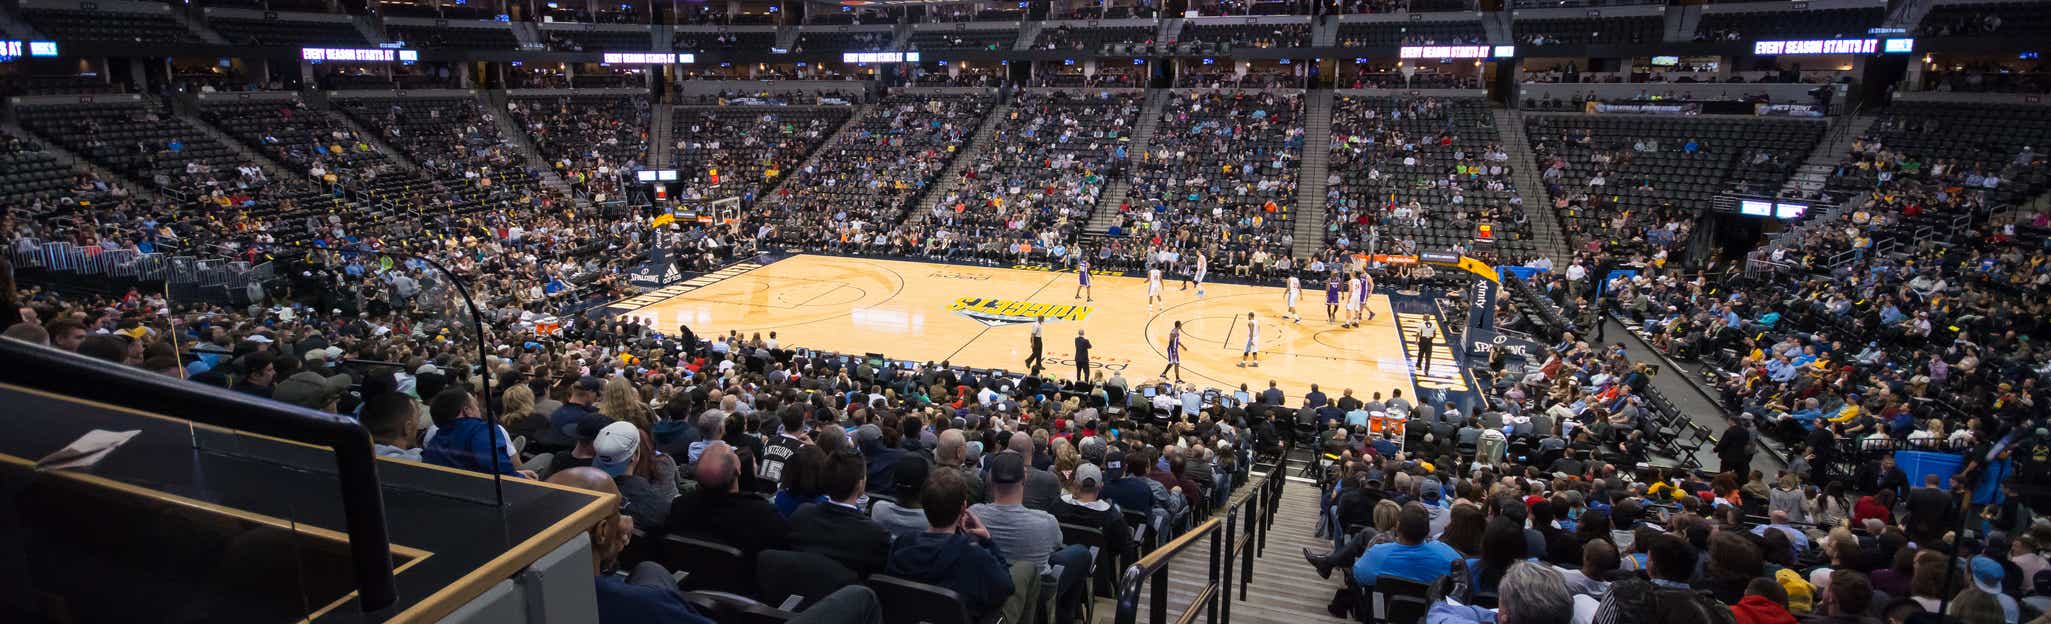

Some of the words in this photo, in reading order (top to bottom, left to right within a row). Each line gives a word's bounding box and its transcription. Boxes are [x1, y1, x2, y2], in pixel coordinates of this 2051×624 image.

[8, 41, 22, 56] AT
[1754, 41, 1785, 55] EVERY
[1785, 40, 1823, 54] SEASON
[1823, 40, 1862, 53] STARTS
[1862, 39, 1878, 53] AT
[630, 272, 659, 283] SPALDING
[662, 273, 682, 285] adidas
[1475, 279, 1489, 309] xfinity
[945, 296, 1096, 322] NUGGETS
[1473, 341, 1526, 356] SPANG
[764, 445, 794, 460] ANTHONY
[760, 459, 785, 481] 15
